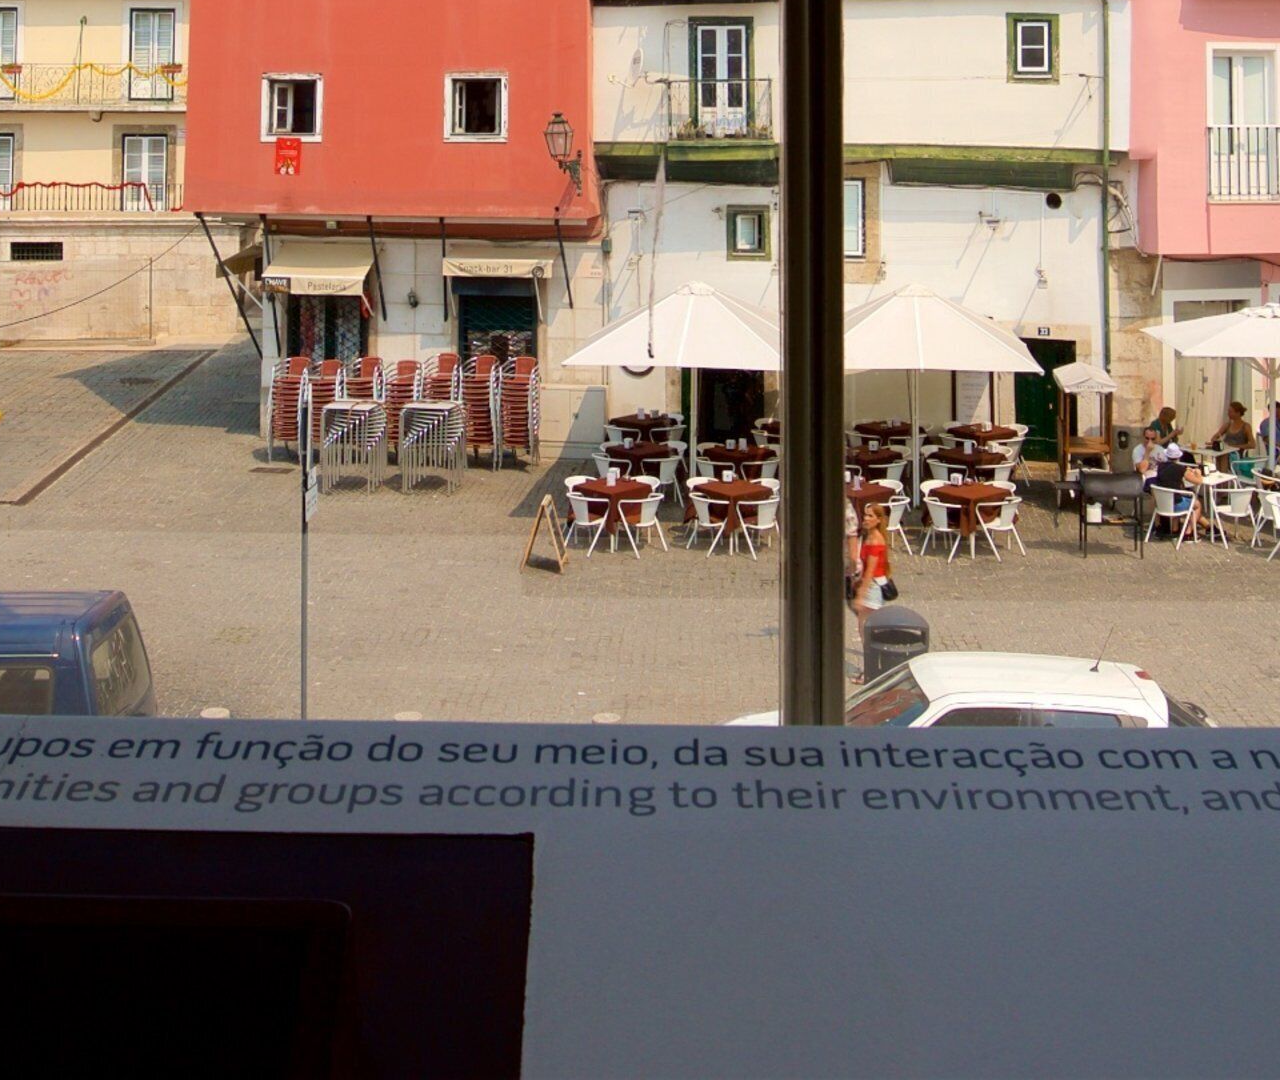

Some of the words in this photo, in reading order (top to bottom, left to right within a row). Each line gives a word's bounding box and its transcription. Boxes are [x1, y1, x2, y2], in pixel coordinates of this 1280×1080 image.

[108, 737, 181, 760] em
[195, 731, 353, 769] função
[367, 734, 424, 764] do
[436, 741, 519, 764] seu
[533, 739, 659, 770] meio,
[672, 738, 728, 767] da
[743, 745, 825, 768] sua
[840, 740, 1085, 778] interacção
[1096, 745, 1199, 770] com
[1211, 745, 1239, 770] a
[131, 773, 227, 804] and
[233, 780, 404, 814] groups
[418, 778, 657, 818] according
[667, 780, 719, 809] to
[730, 779, 849, 811] their
[860, 781, 1190, 817] environment,
